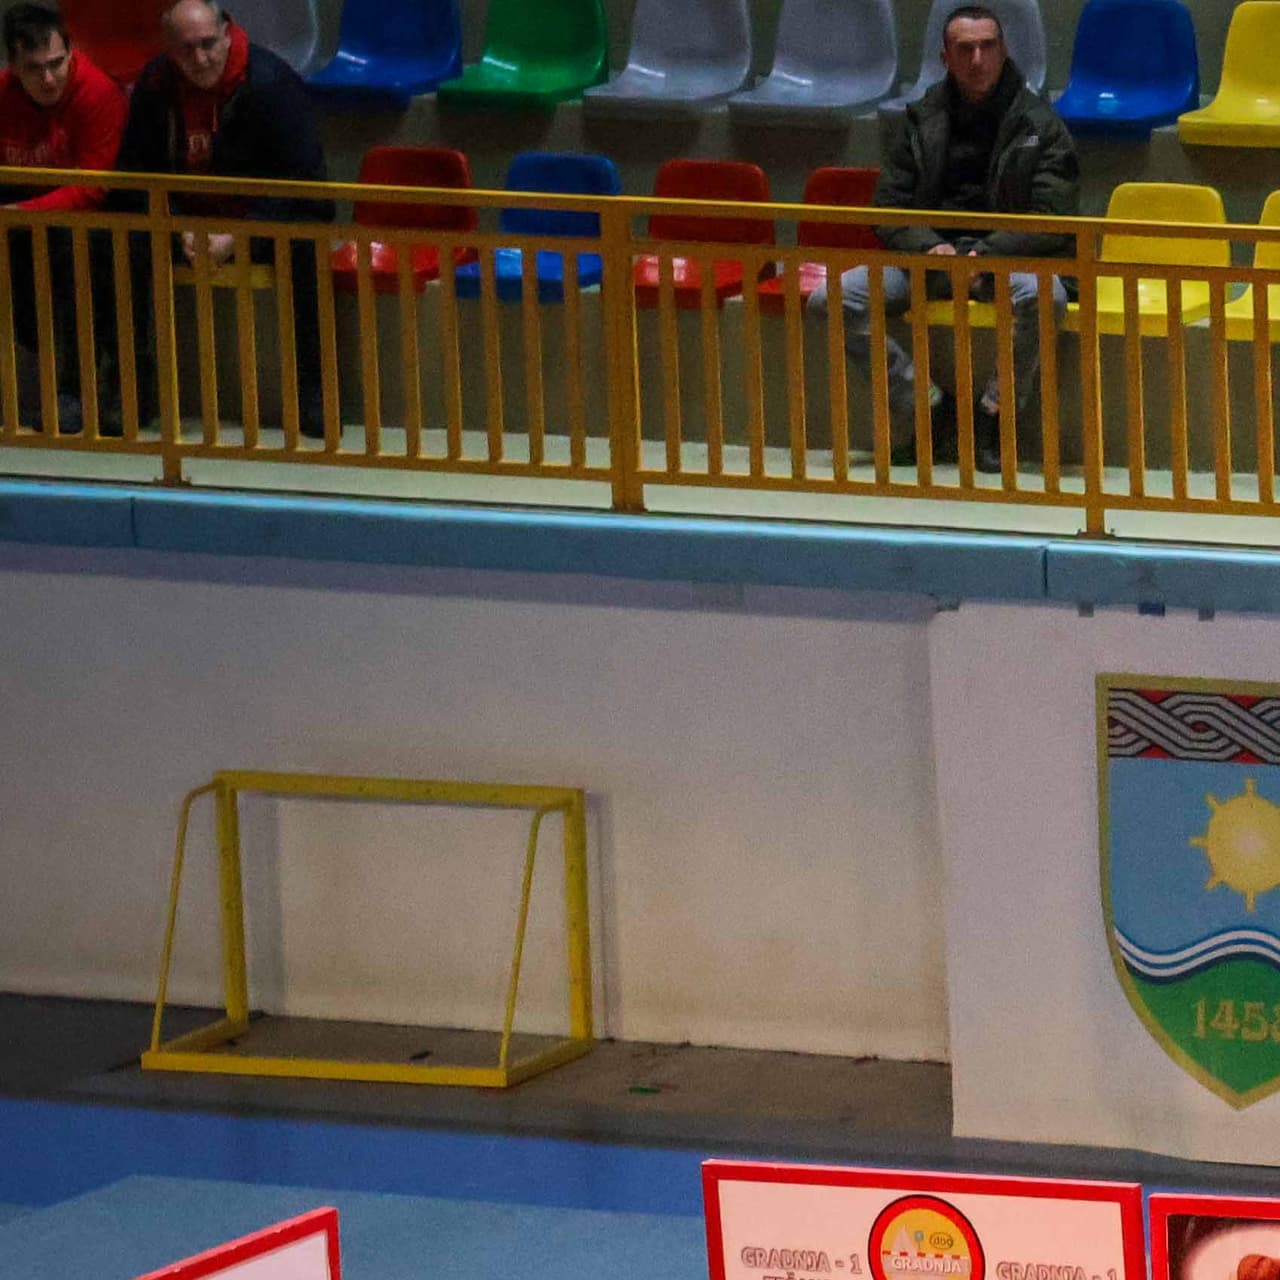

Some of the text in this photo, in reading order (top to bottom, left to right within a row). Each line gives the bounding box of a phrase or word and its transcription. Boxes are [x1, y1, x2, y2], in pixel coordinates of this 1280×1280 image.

[741, 1245, 831, 1274] GRADNJA
[848, 1255, 863, 1275] 1
[891, 1256, 962, 1274] GRADNJA
